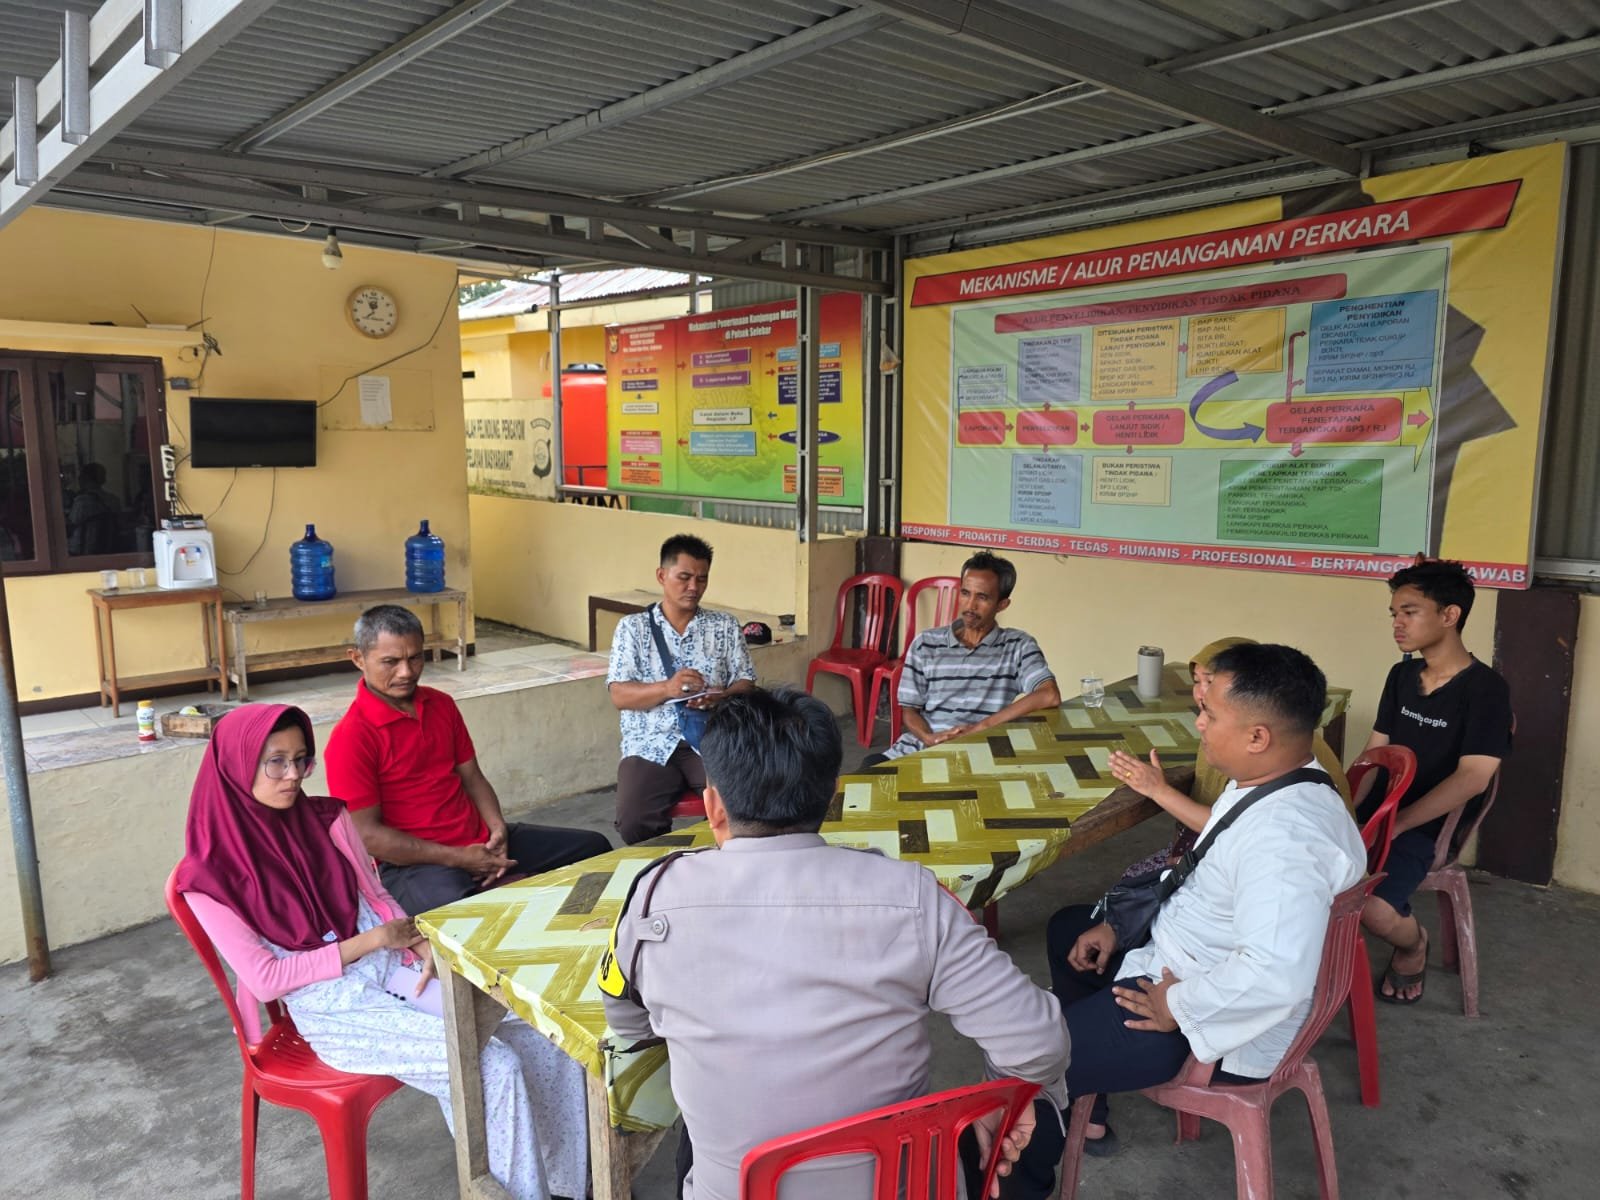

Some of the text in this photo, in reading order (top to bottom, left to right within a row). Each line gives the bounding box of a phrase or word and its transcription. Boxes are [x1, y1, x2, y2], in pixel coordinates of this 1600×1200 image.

[959, 210, 1410, 294] MEKANISME / ALUR PENANGANAN PERKARA
[1201, 293, 1246, 306] TINDAK
[1251, 286, 1300, 299] PIDANA
[1339, 300, 1406, 313] PENGHENTIAN
[750, 311, 780, 323] Kunjungan
[1346, 310, 1403, 321] PENYIDIKAN
[1290, 404, 1375, 415] GELAR PERKARA
[1302, 415, 1361, 424] PENETAPAN
[1115, 431, 1137, 439] HENTI
[1280, 426, 1337, 435] TERSANGKA
[1289, 462, 1308, 470] ALAT
[1331, 532, 1369, 540] PERKARA
[901, 525, 951, 538] RESPONSIF
[959, 530, 1008, 544] PROAKTIF
[1016, 535, 1060, 548] CERDAS
[1070, 539, 1109, 553] TEGAS
[1119, 545, 1180, 559] HUMANIS
[1191, 549, 1296, 568] PROFESIONAL
[1463, 566, 1526, 583] AWAB
